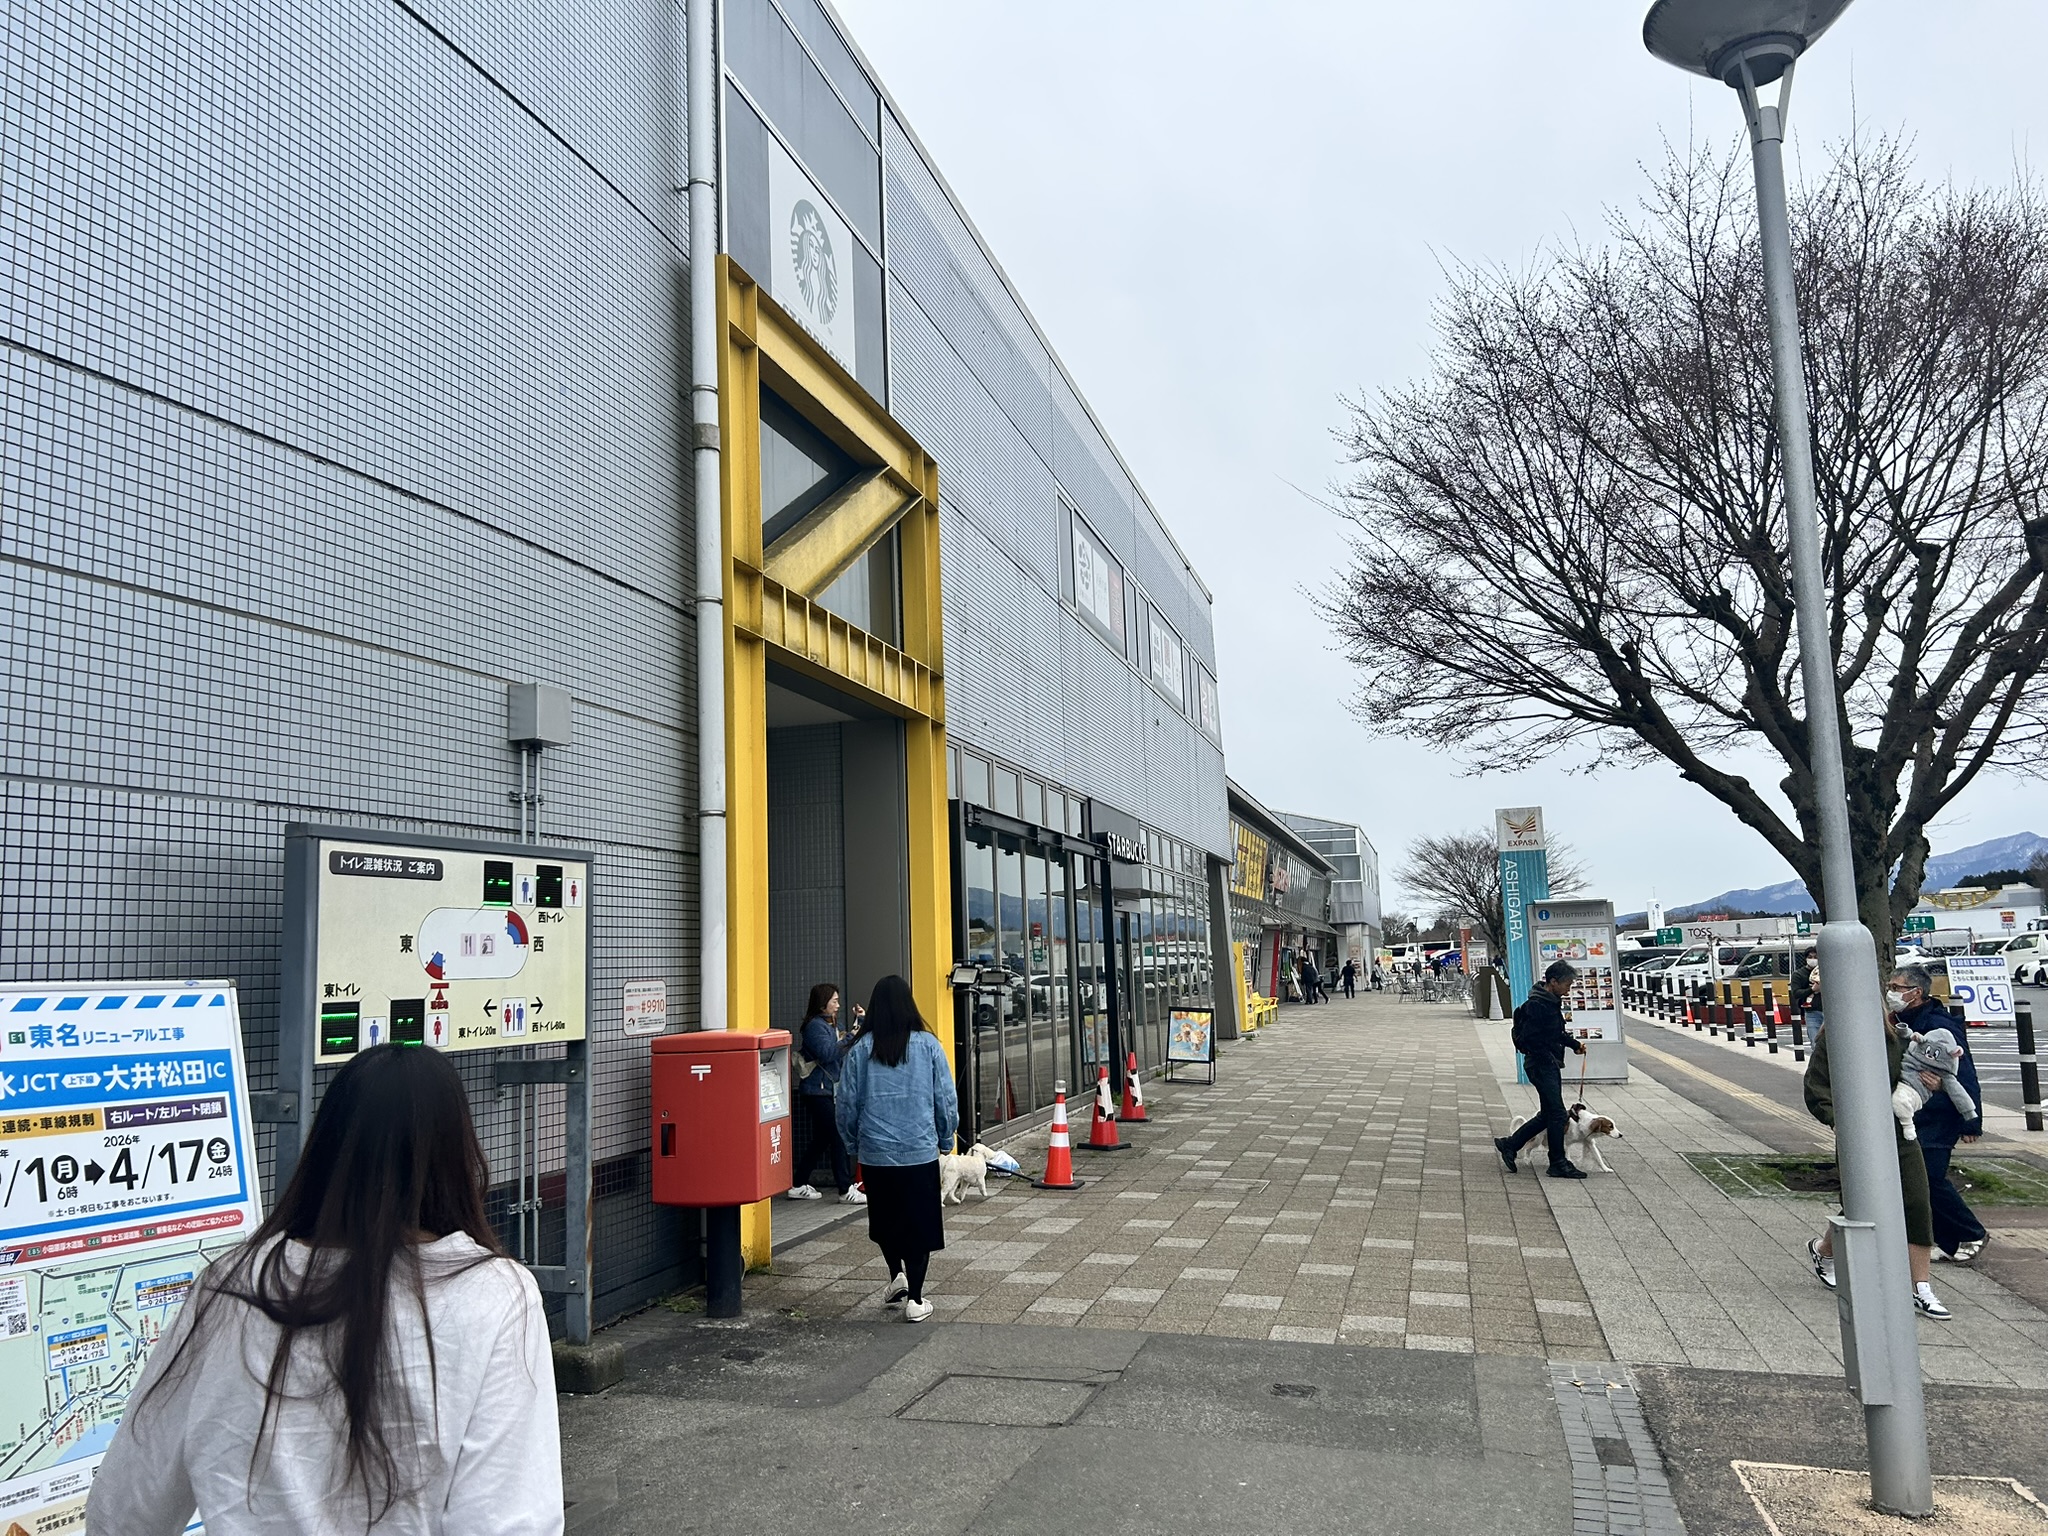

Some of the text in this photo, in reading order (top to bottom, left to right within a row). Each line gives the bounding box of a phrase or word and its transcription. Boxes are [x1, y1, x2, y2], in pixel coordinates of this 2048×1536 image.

[1107, 831, 1148, 864] STARBUCKS
[1507, 839, 1539, 847] EXPASA
[339, 856, 436, 875] トイレ混雑状況 ご案内
[1503, 859, 1524, 942] ASHIGARA
[538, 911, 564, 924] 西トイレ
[1688, 927, 1713, 938] TOSS
[399, 933, 414, 953] 東
[533, 936, 544, 952] 西
[324, 982, 361, 998] 東トイレ
[641, 998, 665, 1014] #9910
[10, 1033, 23, 1043] E1
[458, 1026, 497, 1038] 東トイレ20m
[103, 1062, 227, 1092] 大井松田IC
[0, 1112, 95, 1134] 連続・車線規制
[103, 1134, 140, 1148] 2026年
[770, 1151, 782, 1165] POST
[0, 1157, 48, 1208] /1
[109, 1138, 204, 1191] 4/17
[57, 1165, 233, 1201] 6時 24時
